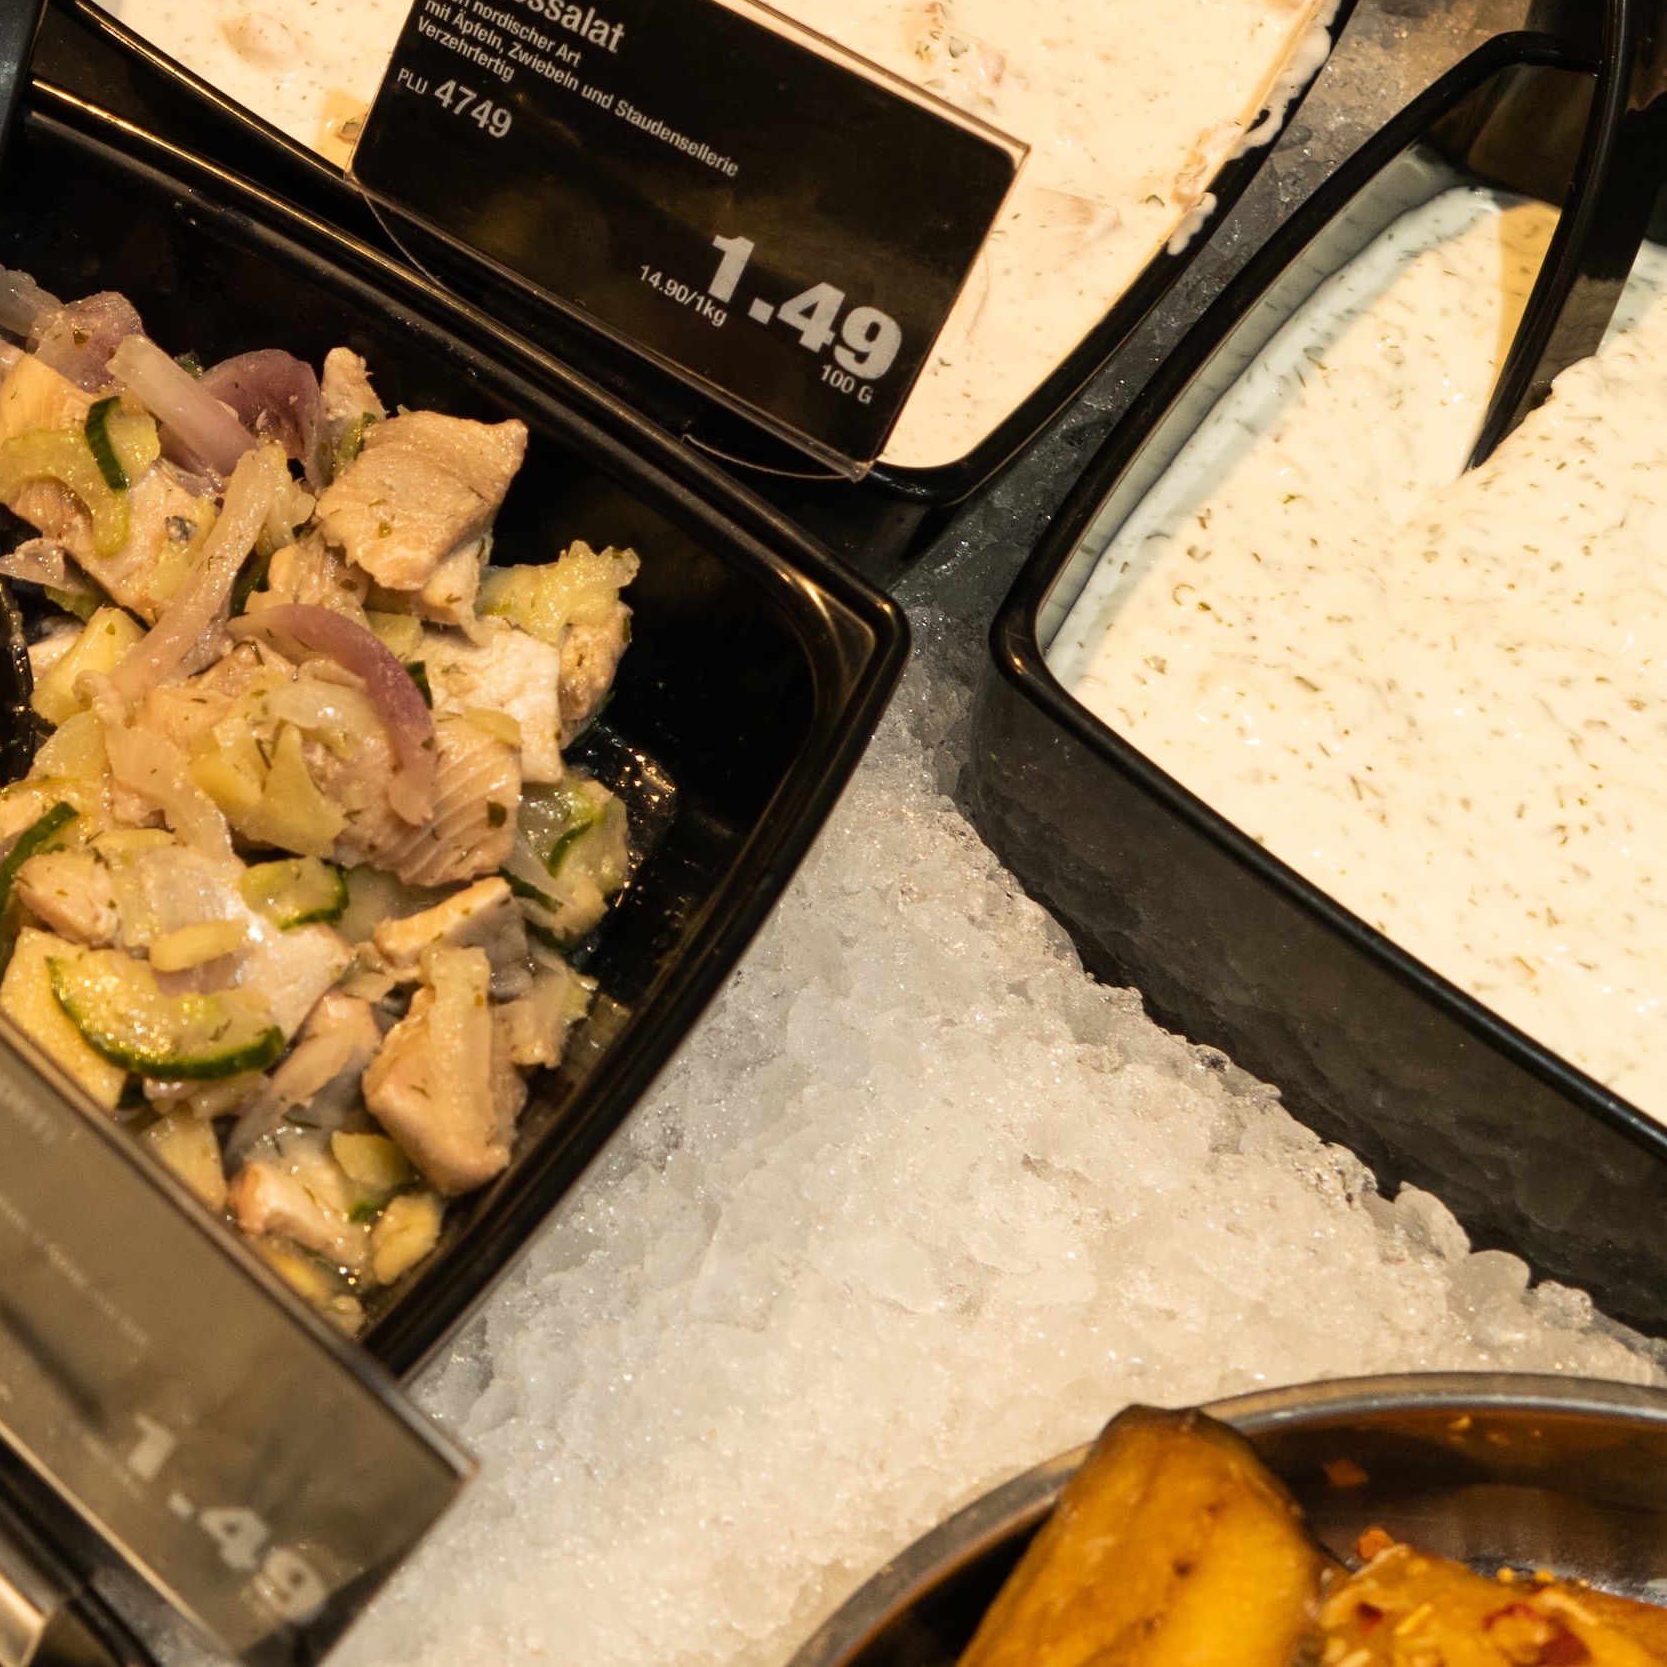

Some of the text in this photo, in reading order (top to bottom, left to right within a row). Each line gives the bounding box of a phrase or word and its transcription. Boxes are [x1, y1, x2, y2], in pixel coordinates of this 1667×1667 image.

[417, 15, 516, 83] Verzehrfertig
[555, 42, 582, 68] Art
[397, 67, 513, 139] PLU 4749
[451, 8, 504, 55] Äpfeln,
[507, 41, 579, 92] Zwiebeln
[581, 82, 615, 110] und
[614, 99, 739, 179] Staudensellerie
[638, 264, 728, 328] 14.90/1kg
[707, 234, 903, 382] 1.49
[819, 362, 874, 406] 100 G
[127, 1412, 328, 1624] 1.49
